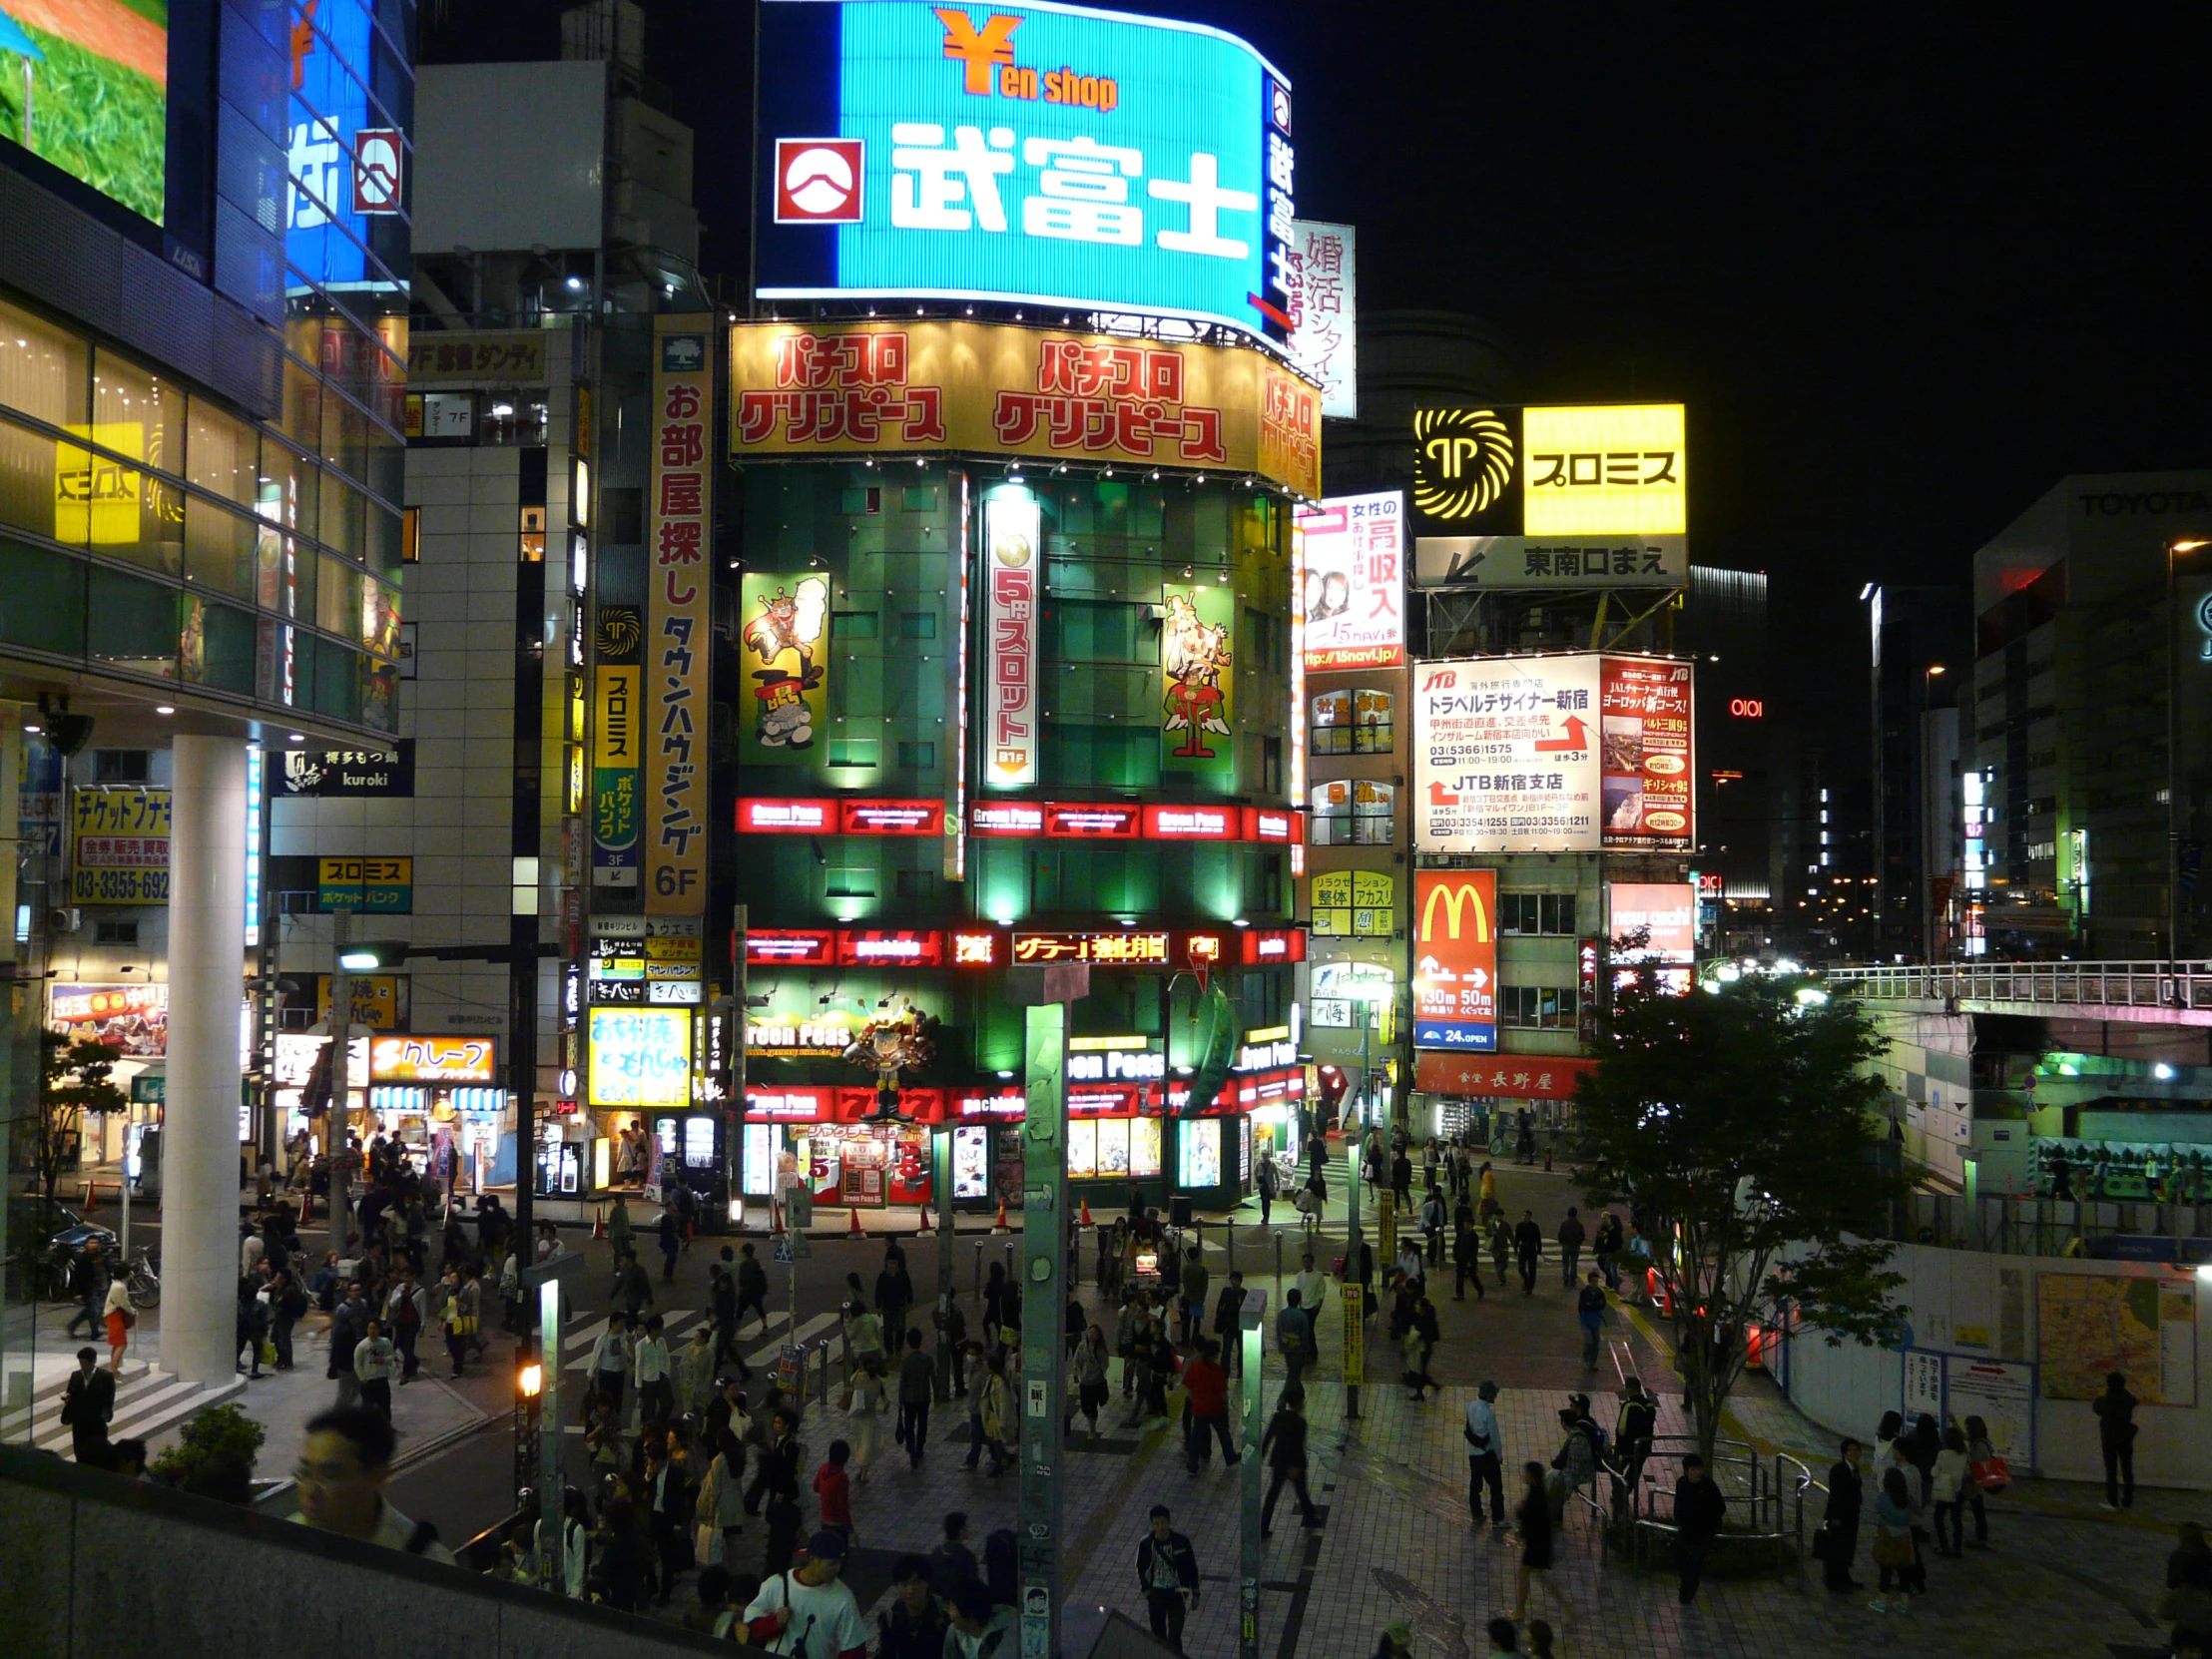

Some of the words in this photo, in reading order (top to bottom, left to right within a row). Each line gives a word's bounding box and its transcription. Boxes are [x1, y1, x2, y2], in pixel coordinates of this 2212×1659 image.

[1046, 66, 1119, 112] shop
[891, 123, 1258, 259] 武富士
[1269, 132, 1296, 296] 武富士
[777, 331, 908, 389] パチスロ
[1037, 339, 1185, 403] パチスロ
[449, 412, 469, 423] 7F
[739, 386, 946, 444] グリンピース
[993, 390, 1227, 463] グリンピース
[1532, 450, 1677, 487] プロミス
[658, 383, 705, 606] お部屋探し
[2078, 490, 2211, 516] TOYOTA
[1352, 500, 1397, 518] 女性の
[1369, 519, 1397, 619] 高収入
[1523, 545, 1668, 576] 東南口まえ
[993, 568, 1032, 747] 5円スロット
[1422, 670, 1457, 693] JTB
[1670, 668, 1689, 682] JTB
[1469, 679, 1544, 691] 海外旅行専門店
[1609, 682, 1679, 698] JALチャーター直行便
[1429, 689, 1589, 715] トラベルデザイナー新宿
[608, 676, 628, 757] プロミス
[1429, 715, 1550, 730] 甲州街道直進、交差点先
[661, 615, 702, 856] タウンハウジング
[1429, 729, 1550, 742] インザルーム新宿本店向かい
[324, 751, 399, 765] 博多もつ鍋
[998, 752, 1024, 764] B1F
[1429, 744, 1512, 756] 03(5366)1575
[1554, 751, 1589, 763] 徒歩3分
[342, 773, 388, 787] kuroki
[1451, 773, 1564, 792] JTB新宿支店
[617, 775, 635, 834] ポケット
[599, 792, 616, 839] バンク
[973, 808, 1009, 824] Green
[1445, 817, 1508, 828] 03(3354)1255
[1526, 816, 1589, 827] 03(3356)1211
[85, 839, 112, 854] 金券
[114, 839, 140, 854] 販売
[143, 839, 169, 855] 買取
[608, 855, 624, 865] 3F
[327, 862, 401, 880] プロミス
[655, 865, 699, 896] 6F
[1317, 878, 1388, 887] リラクゼーション
[1318, 889, 1348, 906] 整体
[1357, 889, 1393, 905] アカスリ
[1358, 911, 1373, 928] 憩
[1613, 909, 1647, 926] new
[1650, 906, 1691, 926] asahi
[1579, 946, 1595, 973] 食堂
[648, 964, 699, 976] タウンハウジング
[1420, 990, 1456, 1006] 130m
[1460, 990, 1491, 1006] 50m
[1460, 1007, 1492, 1016] くぐって左
[746, 1024, 797, 1046] reen
[800, 1023, 850, 1046] Peas
[1464, 1034, 1487, 1043] OPEN
[404, 1041, 491, 1065] クレープ
[1107, 1051, 1165, 1077] Peas
[1457, 1072, 1482, 1084] 食堂
[1490, 1071, 1553, 1090] 長野屋
[658, 1086, 687, 1104] 2F
[558, 1103, 576, 1113] リーチ
[809, 1158, 830, 1179] 5
[1030, 1388, 1044, 1400] BNE
